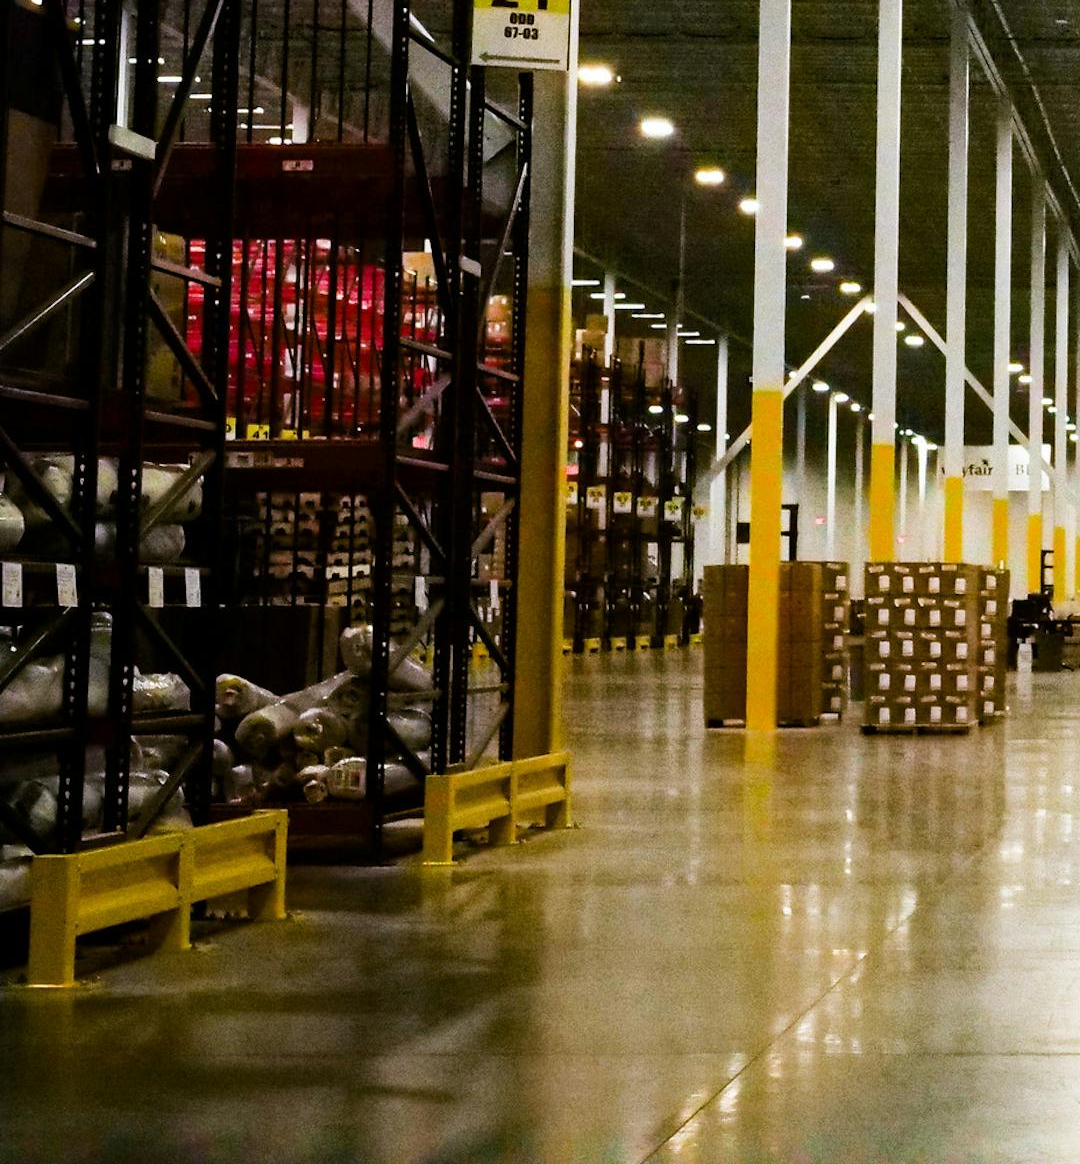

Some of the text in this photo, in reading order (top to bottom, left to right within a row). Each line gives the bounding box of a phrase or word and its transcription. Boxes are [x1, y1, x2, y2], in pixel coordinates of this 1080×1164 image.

[509, 13, 535, 25] ODD
[504, 27, 539, 40] 67-03
[941, 463, 993, 477] yfair
